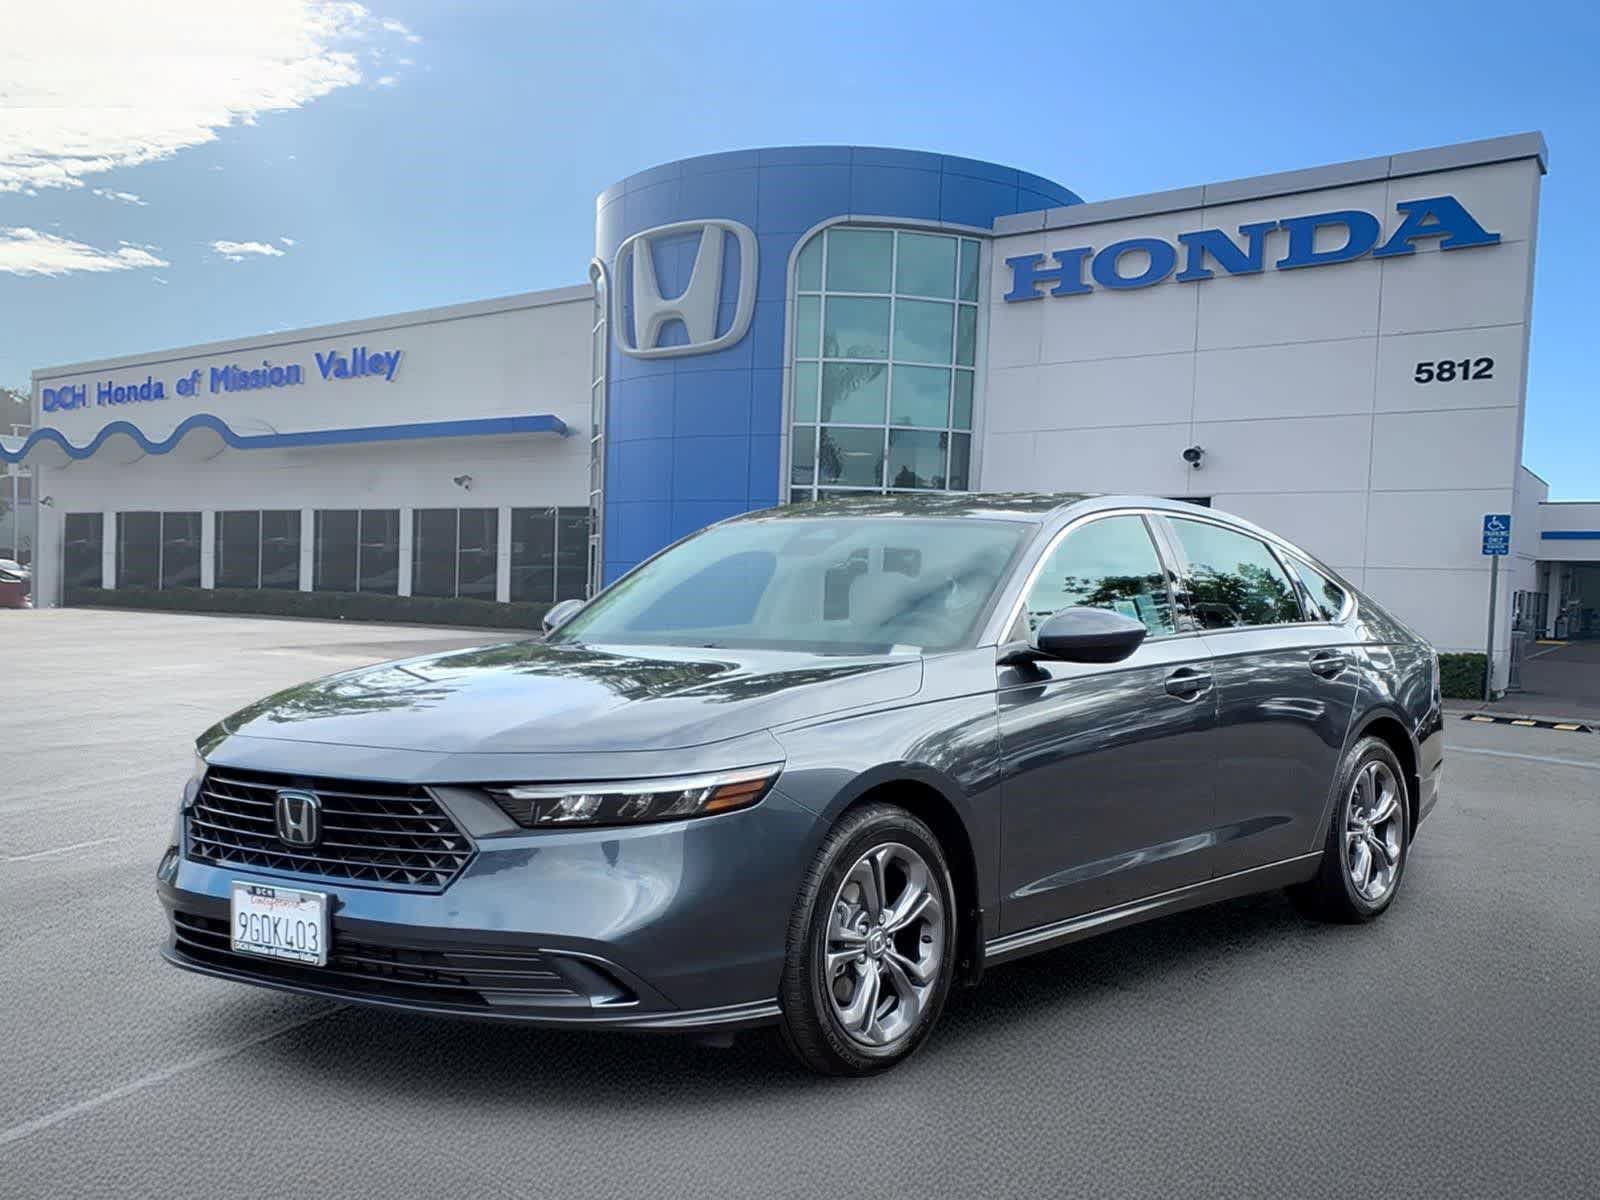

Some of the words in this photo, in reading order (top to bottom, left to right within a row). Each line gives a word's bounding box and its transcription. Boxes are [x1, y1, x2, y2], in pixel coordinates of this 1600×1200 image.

[1003, 195, 1501, 303] HONDA
[42, 384, 87, 412] DCH
[96, 376, 165, 406] Honda
[175, 369, 203, 397] of
[209, 361, 303, 394] Mission
[315, 346, 401, 383] Valley
[1414, 357, 1494, 383] 5812
